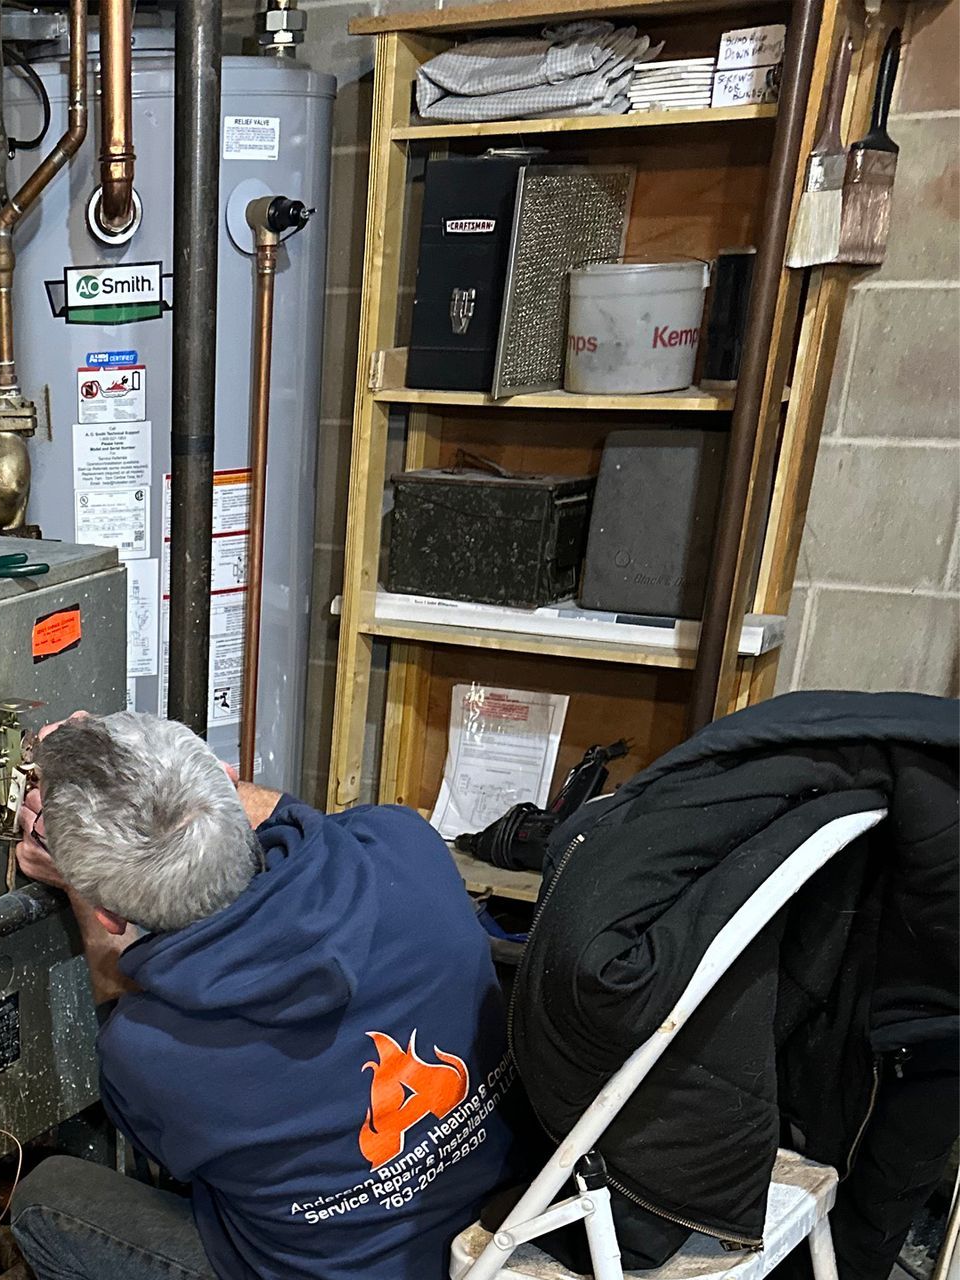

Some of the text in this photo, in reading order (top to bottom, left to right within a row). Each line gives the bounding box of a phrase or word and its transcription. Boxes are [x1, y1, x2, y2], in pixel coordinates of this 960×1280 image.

[234, 118, 253, 126] RELIEF
[450, 221, 490, 231] CRAFTSMAN
[102, 275, 154, 295] Smith
[377, 1140, 430, 1181] Burner
[427, 1095, 481, 1145] Heating
[478, 1083, 487, 1099] &
[487, 1049, 513, 1088] Coolin
[304, 1192, 370, 1224] Service
[371, 1165, 422, 1198] Repair
[425, 1154, 435, 1167] &
[438, 1092, 501, 1159] Installation
[379, 1128, 487, 1210] 763-204-2830
